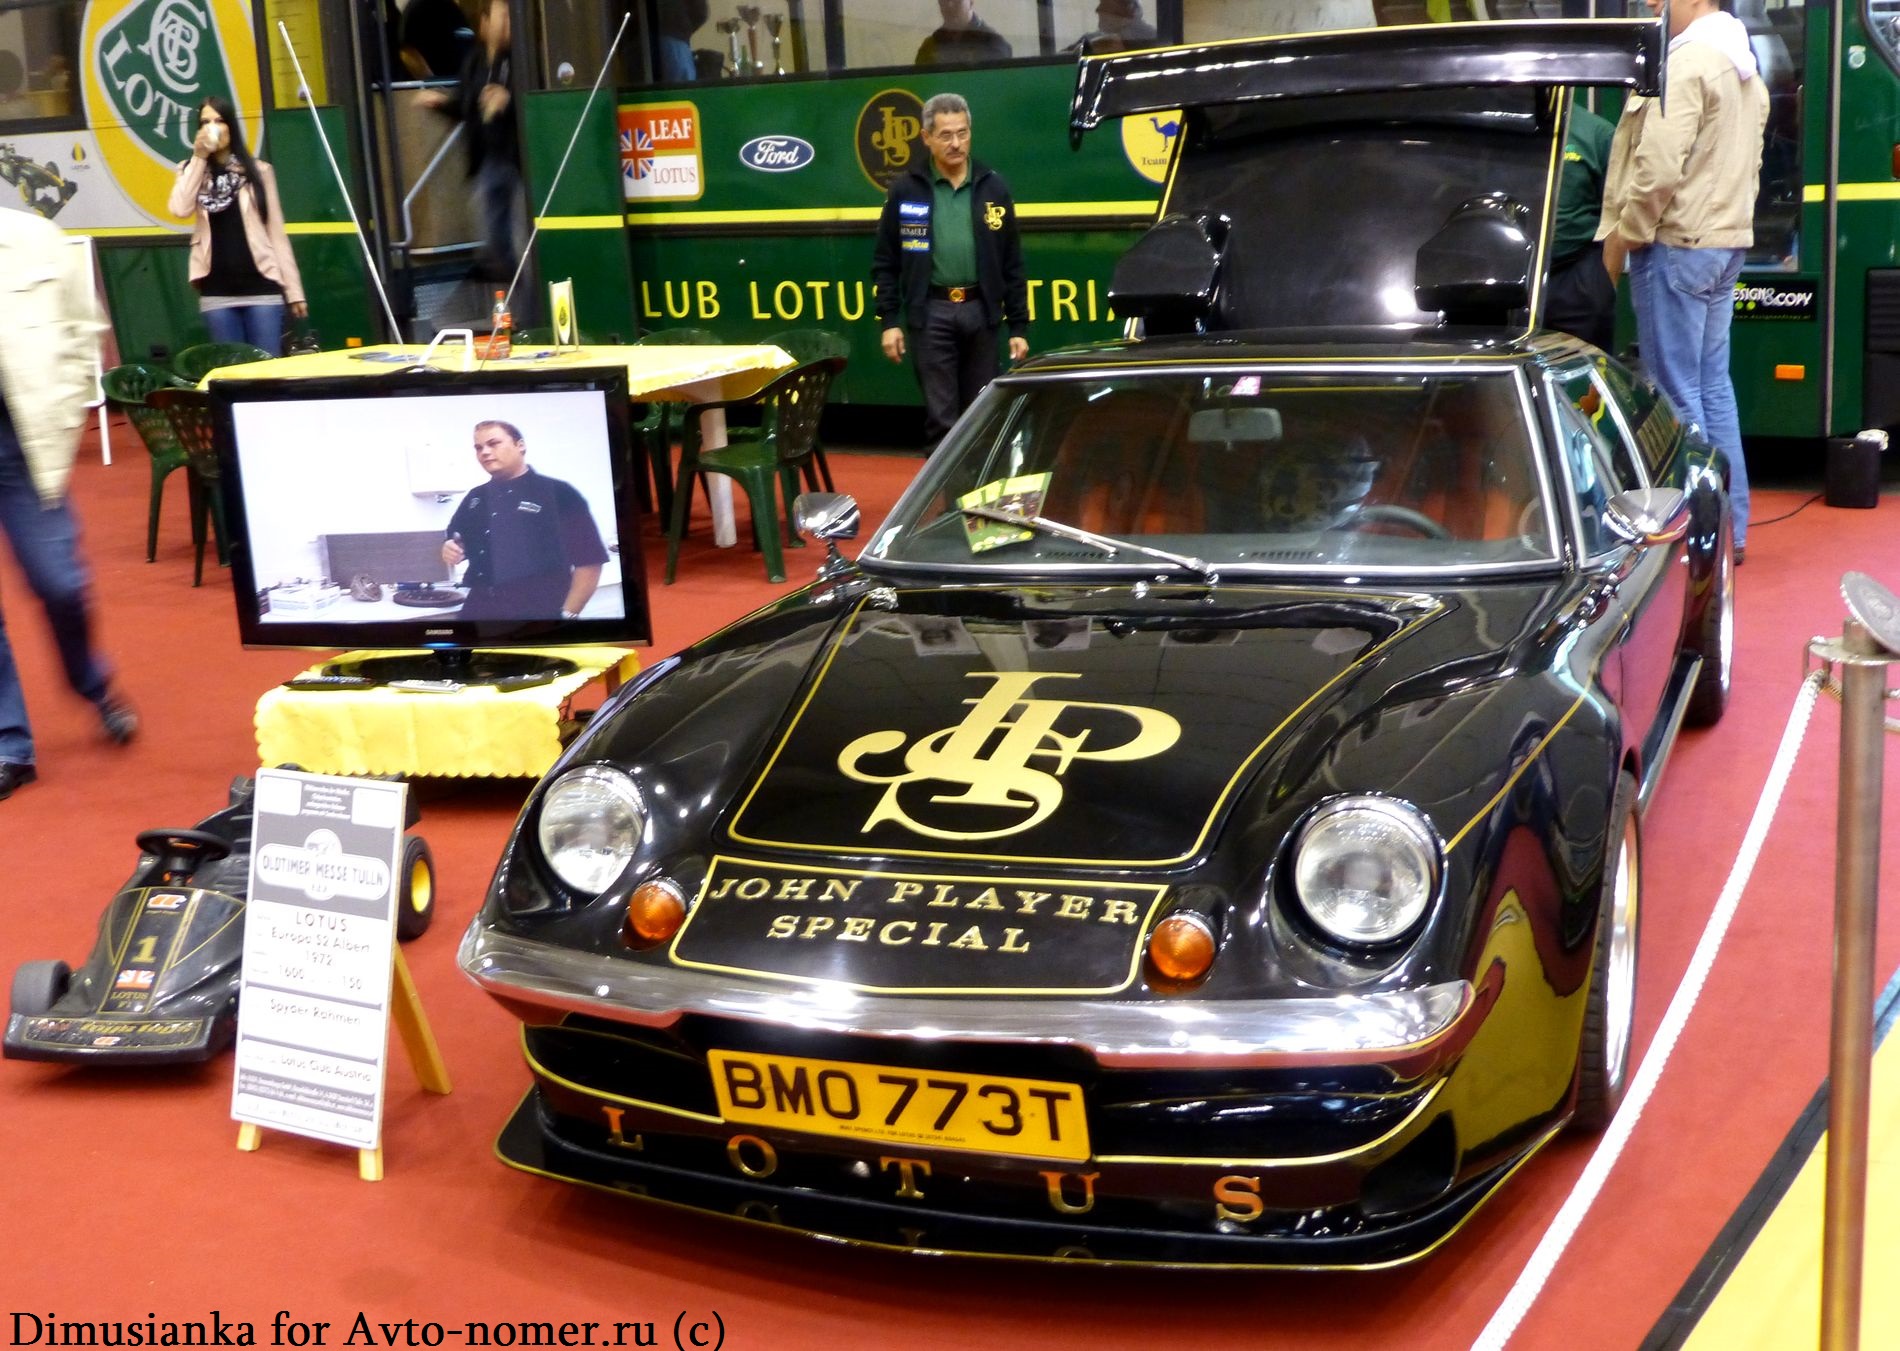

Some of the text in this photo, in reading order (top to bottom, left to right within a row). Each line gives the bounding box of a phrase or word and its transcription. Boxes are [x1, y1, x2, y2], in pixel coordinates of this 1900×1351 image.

[649, 118, 692, 140] LEAF
[753, 139, 800, 165] Ford
[654, 167, 696, 184] LOTUS
[749, 280, 883, 321] LOTU
[315, 862, 348, 882] MESSE
[709, 877, 1140, 925] JOHN PLAYER
[296, 911, 348, 932] LOTUS
[766, 914, 1031, 953] SPECIAL
[130, 935, 159, 963] 1
[110, 991, 149, 1000] LOTUS
[722, 1059, 1072, 1142] BMO 773T
[604, 1106, 1265, 1223] LOTUS
